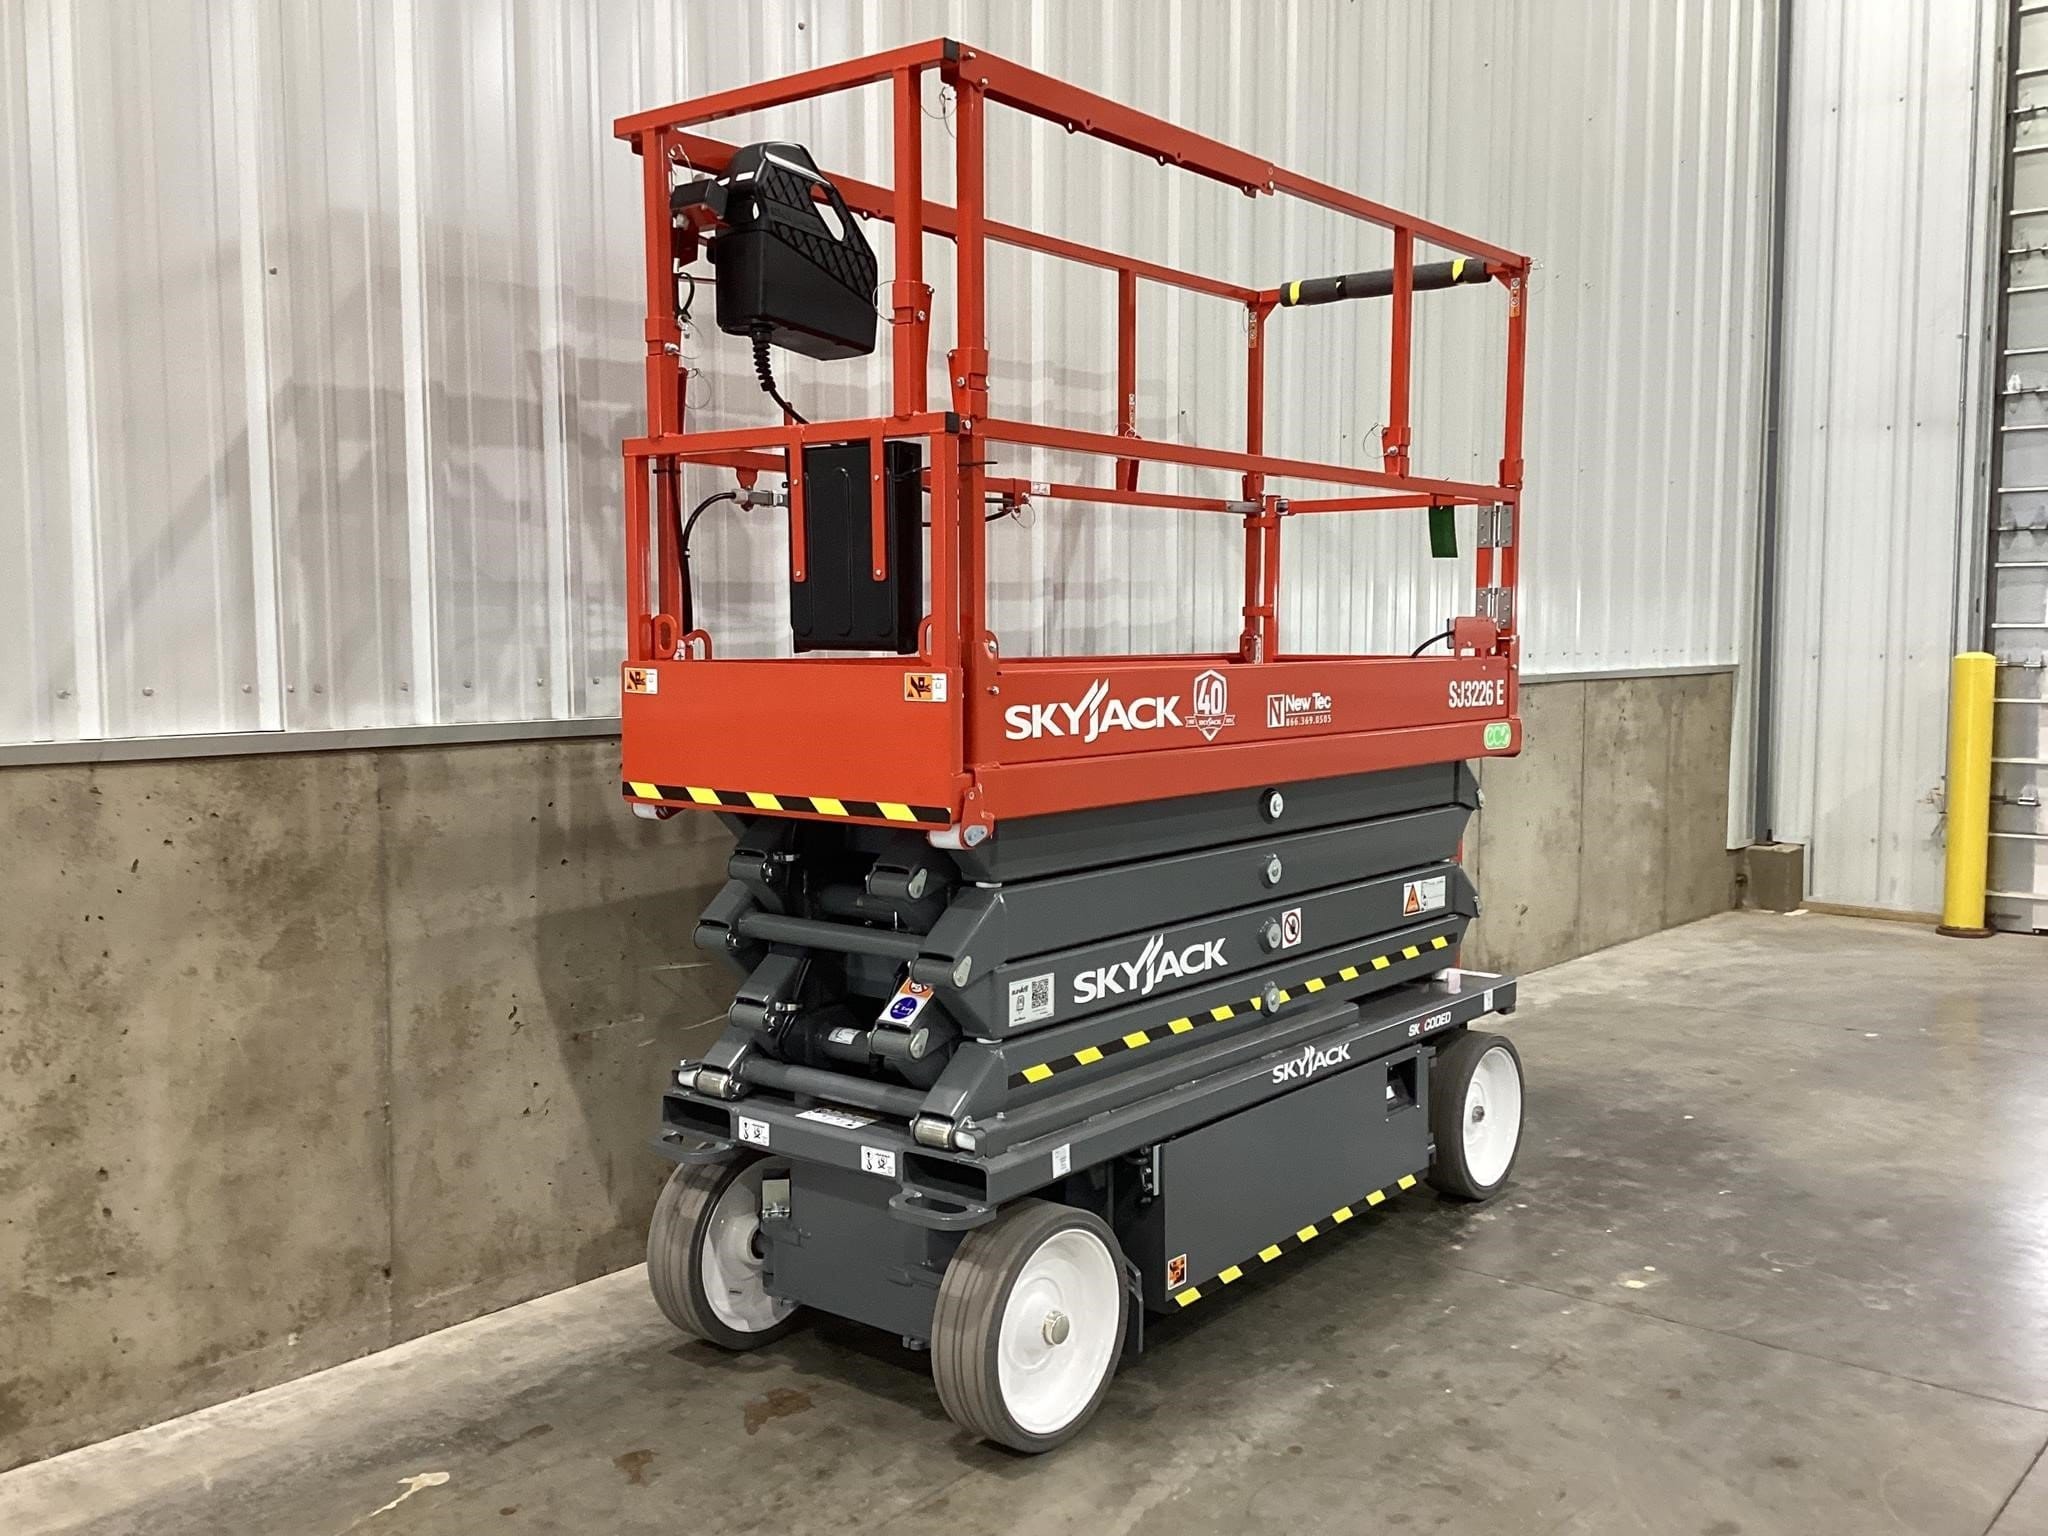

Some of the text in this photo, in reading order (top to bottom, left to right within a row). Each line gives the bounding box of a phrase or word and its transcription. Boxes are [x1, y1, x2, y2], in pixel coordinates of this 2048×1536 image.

[1004, 678, 1183, 743] SKYJACK
[1198, 678, 1222, 714] 40
[1285, 692, 1332, 712] New Tec
[1448, 679, 1504, 708] SJ3226 E
[1073, 933, 1228, 1004] SKYJACK
[1272, 1043, 1351, 1084] SKYJACK
